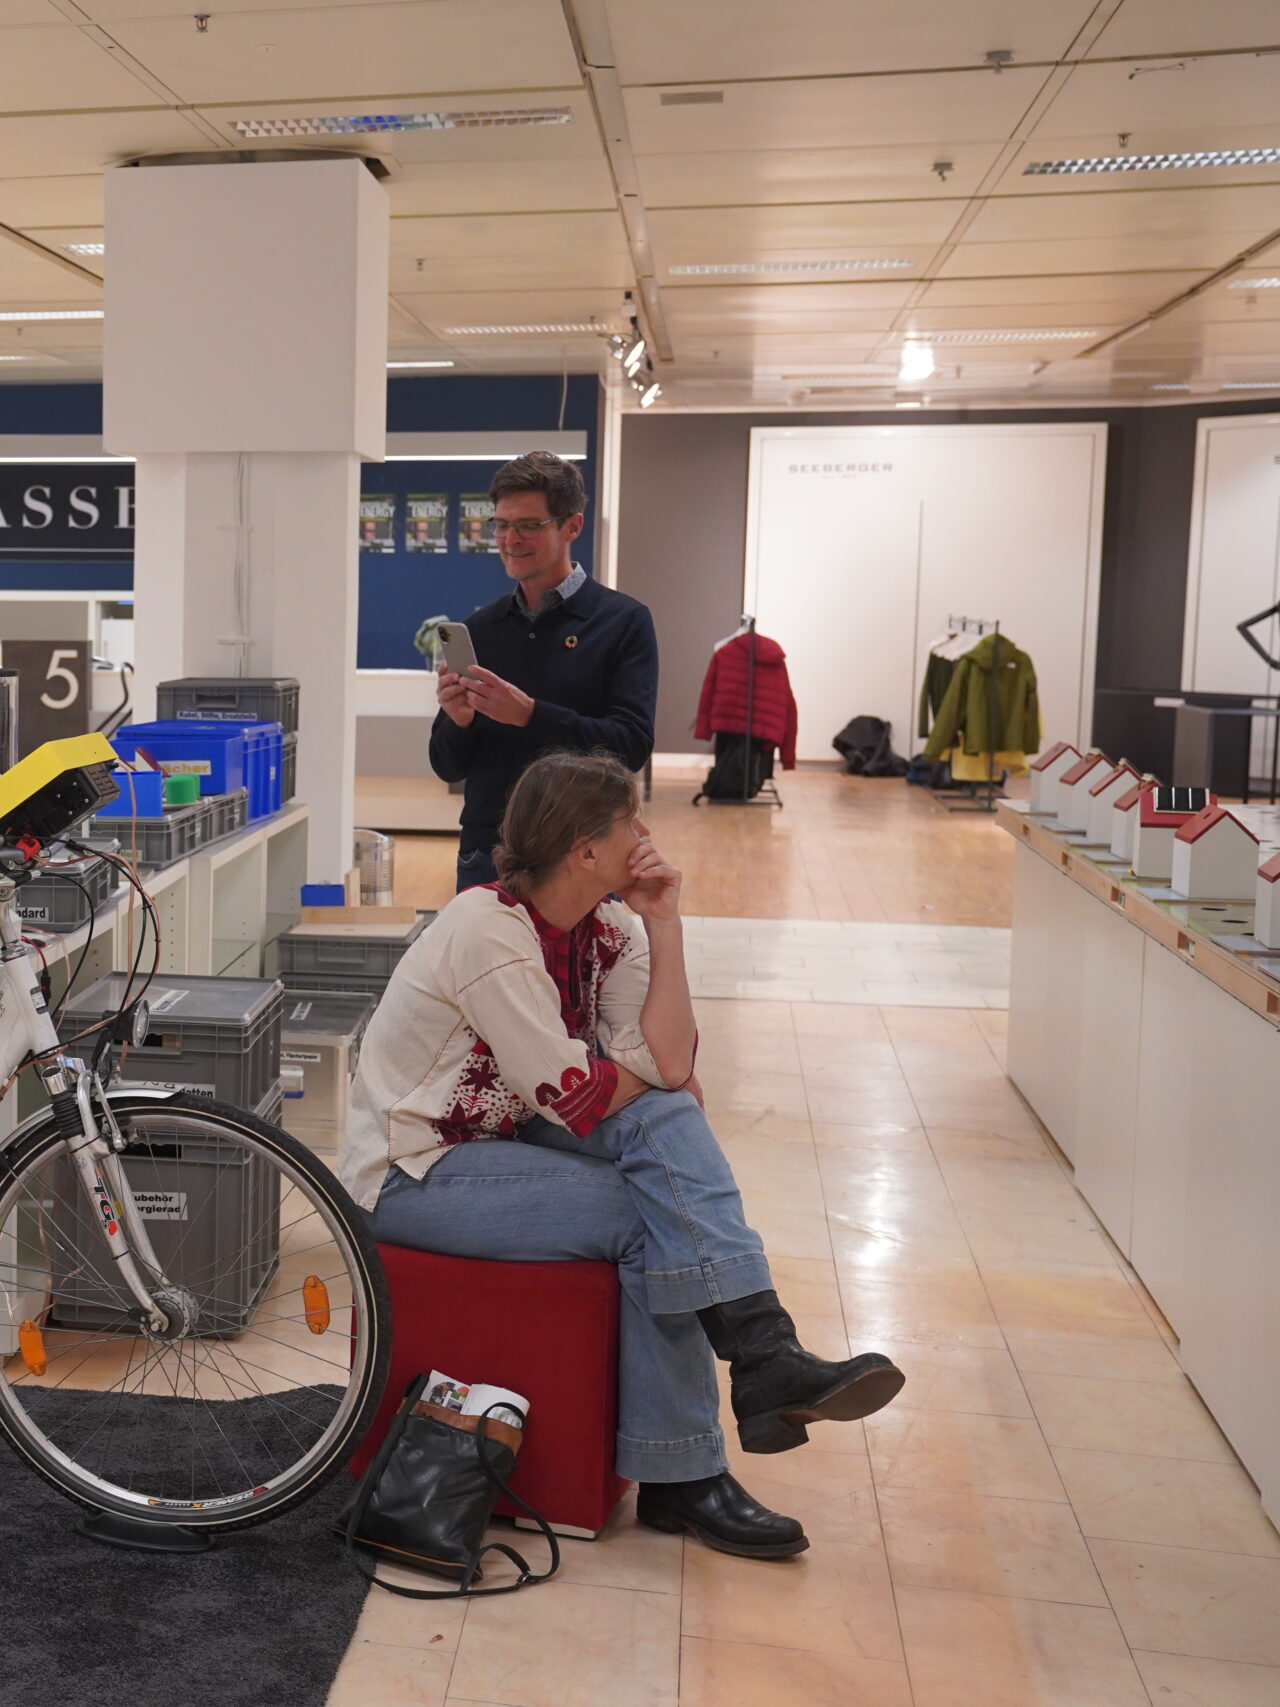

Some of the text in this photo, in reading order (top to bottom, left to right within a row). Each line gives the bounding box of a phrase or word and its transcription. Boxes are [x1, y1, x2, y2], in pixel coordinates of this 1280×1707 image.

[40, 648, 79, 710] 5
[162, 763, 209, 773] ächer
[19, 907, 46, 919] ndard
[134, 1194, 174, 1203] ubehör
